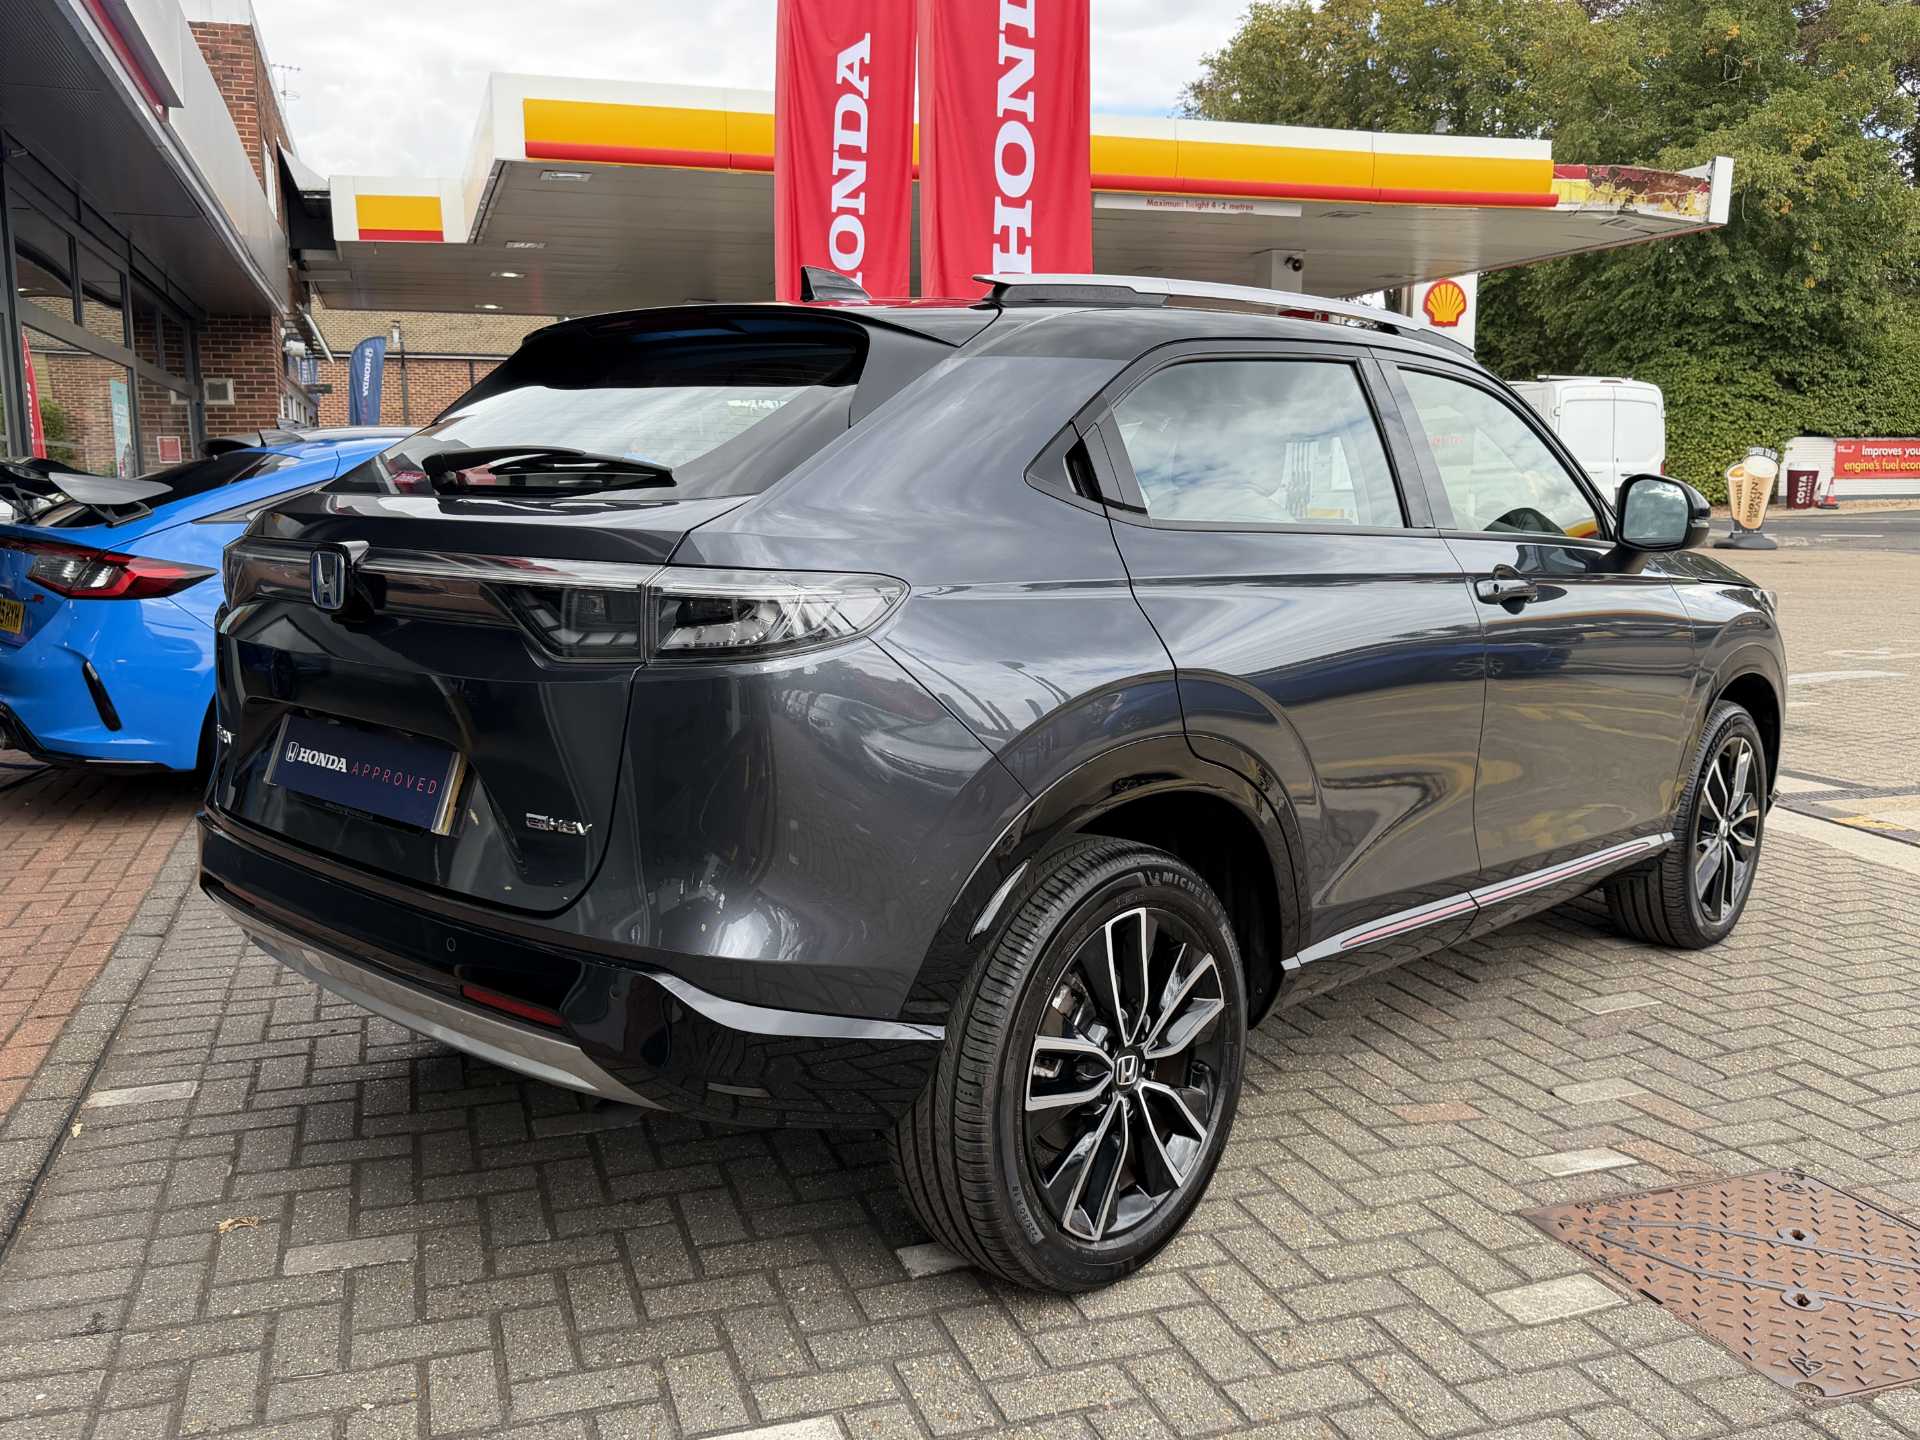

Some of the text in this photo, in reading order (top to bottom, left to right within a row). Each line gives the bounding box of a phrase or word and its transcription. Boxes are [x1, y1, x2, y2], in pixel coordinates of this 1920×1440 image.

[362, 357, 371, 397] HONDA
[1844, 459, 1880, 473] engine's
[1882, 458, 1899, 470] fuel
[1861, 444, 1902, 458] Improves
[1796, 475, 1808, 504] COSTA
[298, 747, 437, 794] HONDA APPROVED
